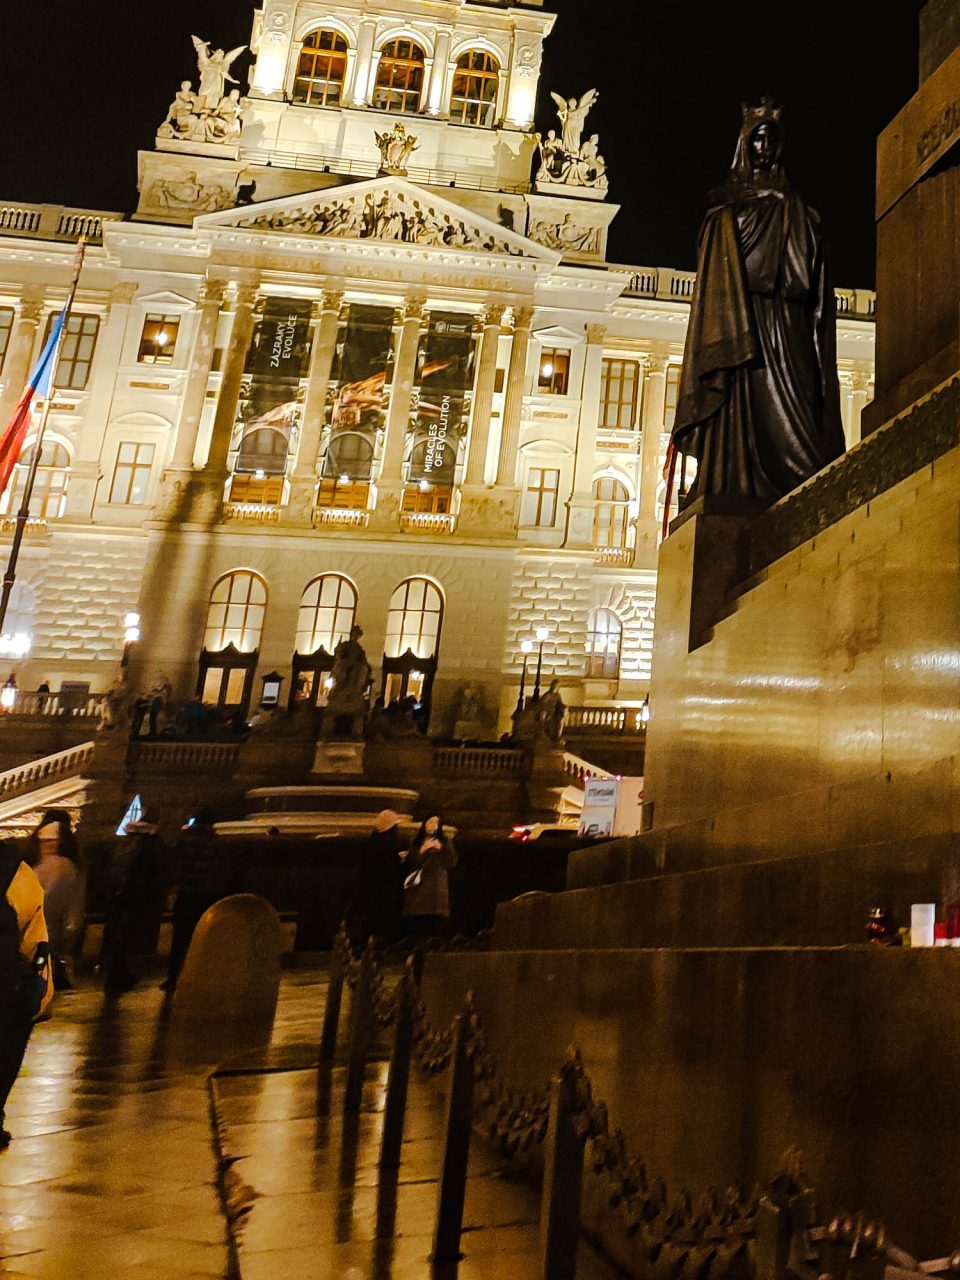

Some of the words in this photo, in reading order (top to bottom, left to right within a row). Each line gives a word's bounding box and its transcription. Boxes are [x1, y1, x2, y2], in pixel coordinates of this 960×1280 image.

[270, 321, 286, 368] ZÁZRAKY
[282, 314, 297, 359] EVOLUCE
[436, 395, 450, 451] EVOLUTION
[424, 424, 437, 473] MIRACLES
[434, 451, 444, 467] OF
